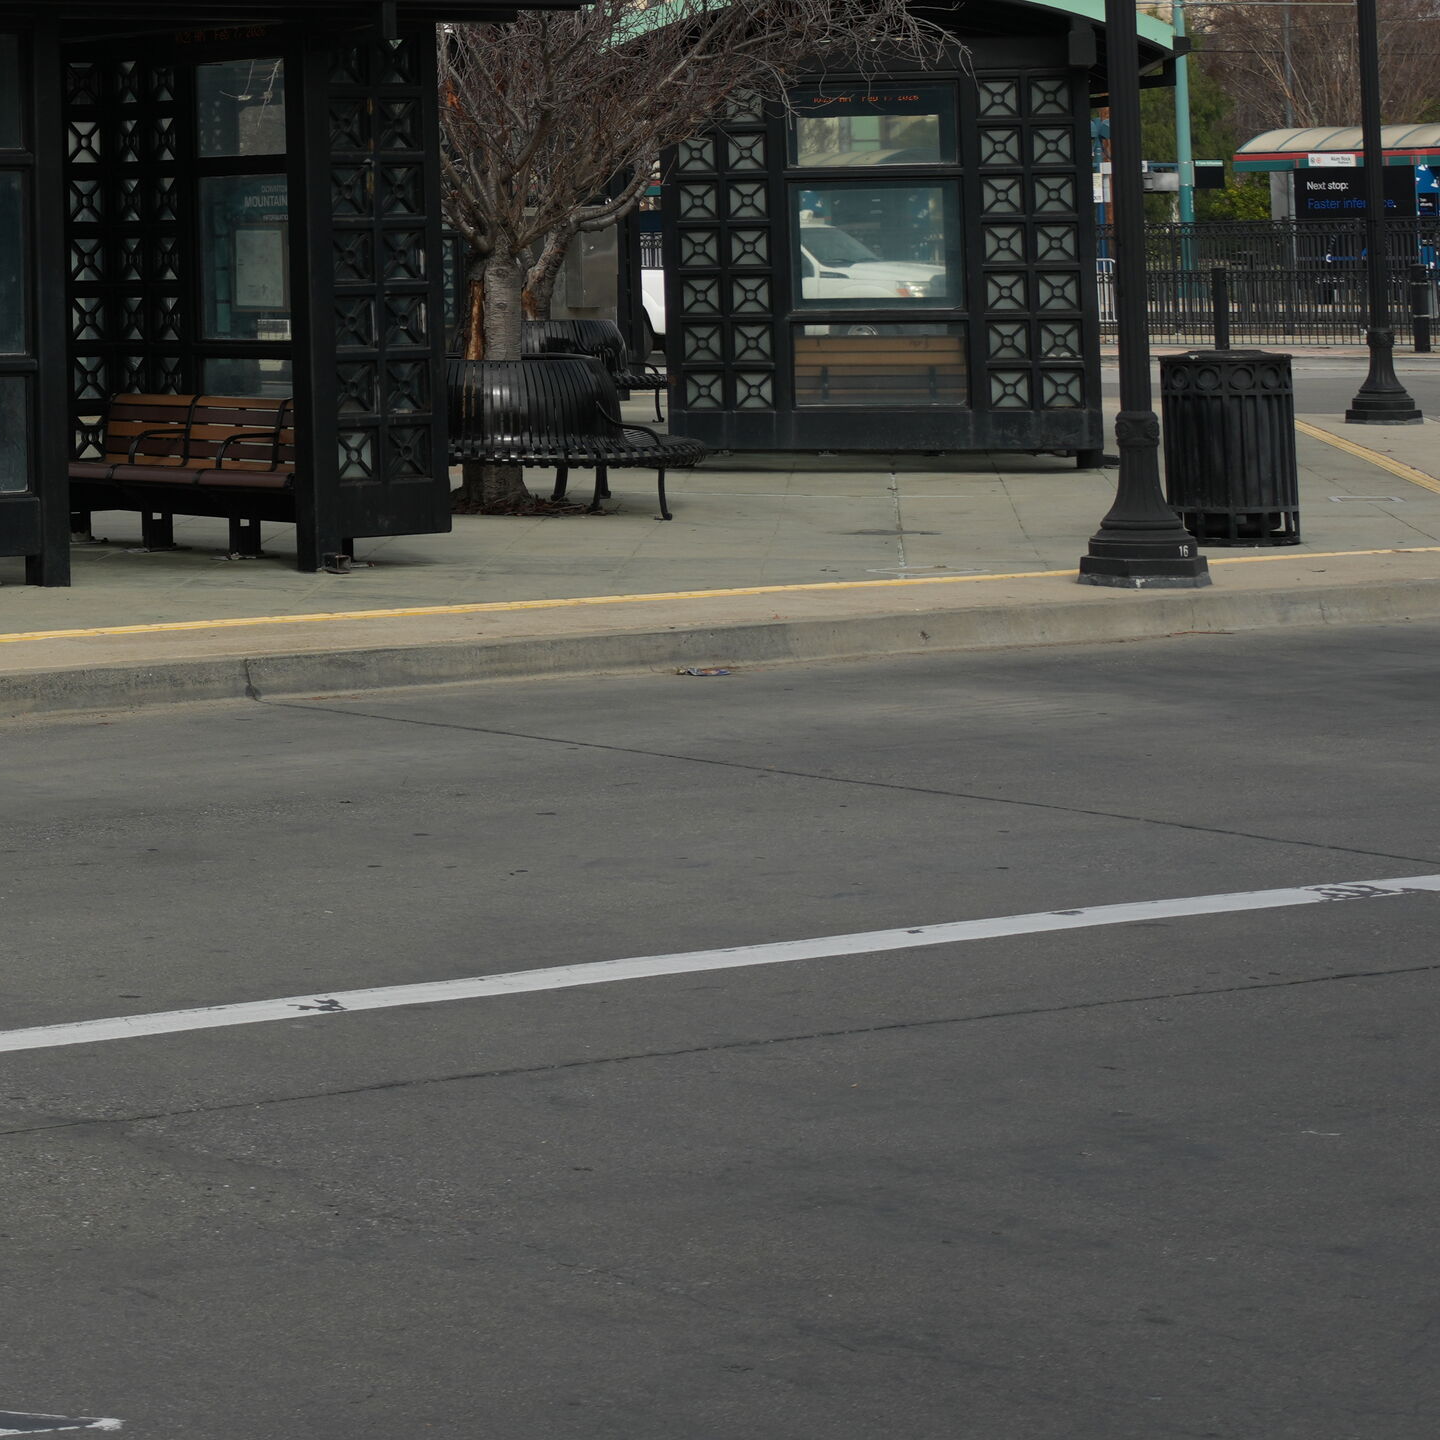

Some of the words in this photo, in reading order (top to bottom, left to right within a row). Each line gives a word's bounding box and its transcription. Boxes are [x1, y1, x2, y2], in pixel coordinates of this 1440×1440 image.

[1306, 181, 1327, 190] Next
[1327, 181, 1349, 191] stop:
[244, 195, 287, 208] MOUNTAIN
[1307, 198, 1340, 209] Faster
[1178, 545, 1189, 558] 16
